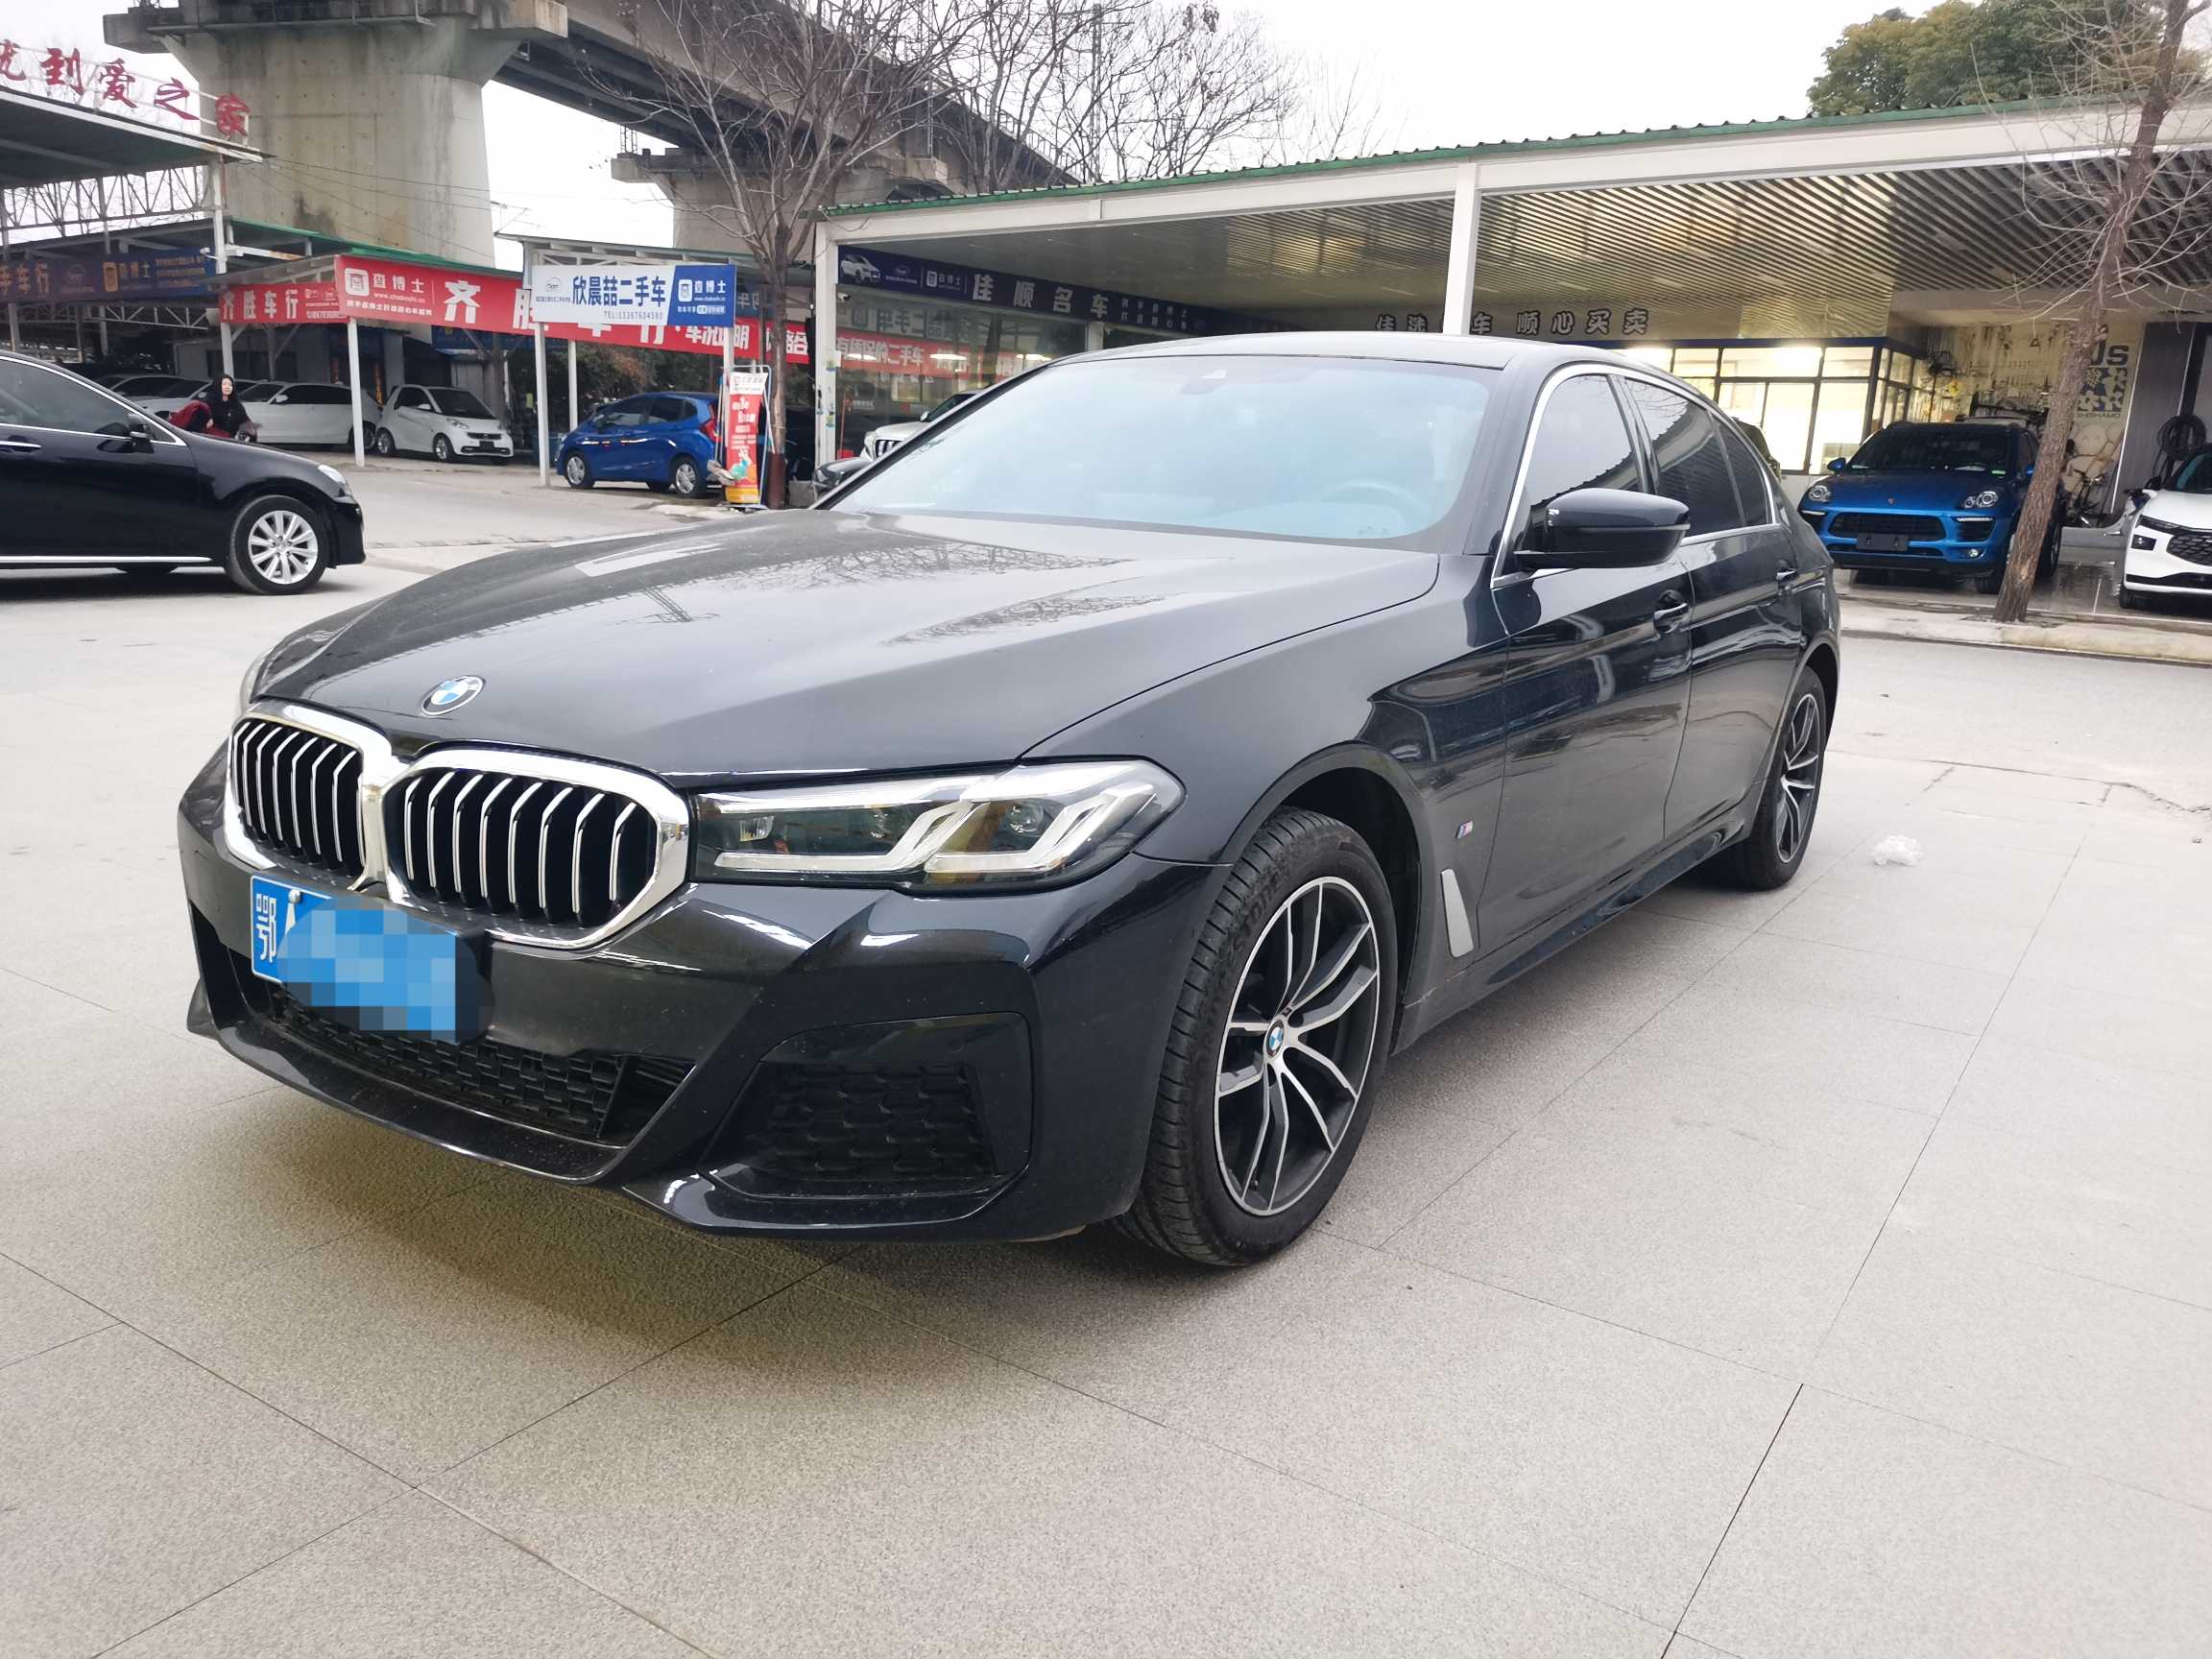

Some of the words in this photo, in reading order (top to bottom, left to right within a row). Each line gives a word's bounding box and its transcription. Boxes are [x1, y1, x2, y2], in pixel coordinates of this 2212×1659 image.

[373, 273, 425, 294] 查博士
[572, 276, 666, 307] 欣晨喆二手车
[694, 279, 727, 294] 查博士
[973, 274, 1109, 319] 佳顺名车
[1517, 309, 1649, 336] 顺心买卖
